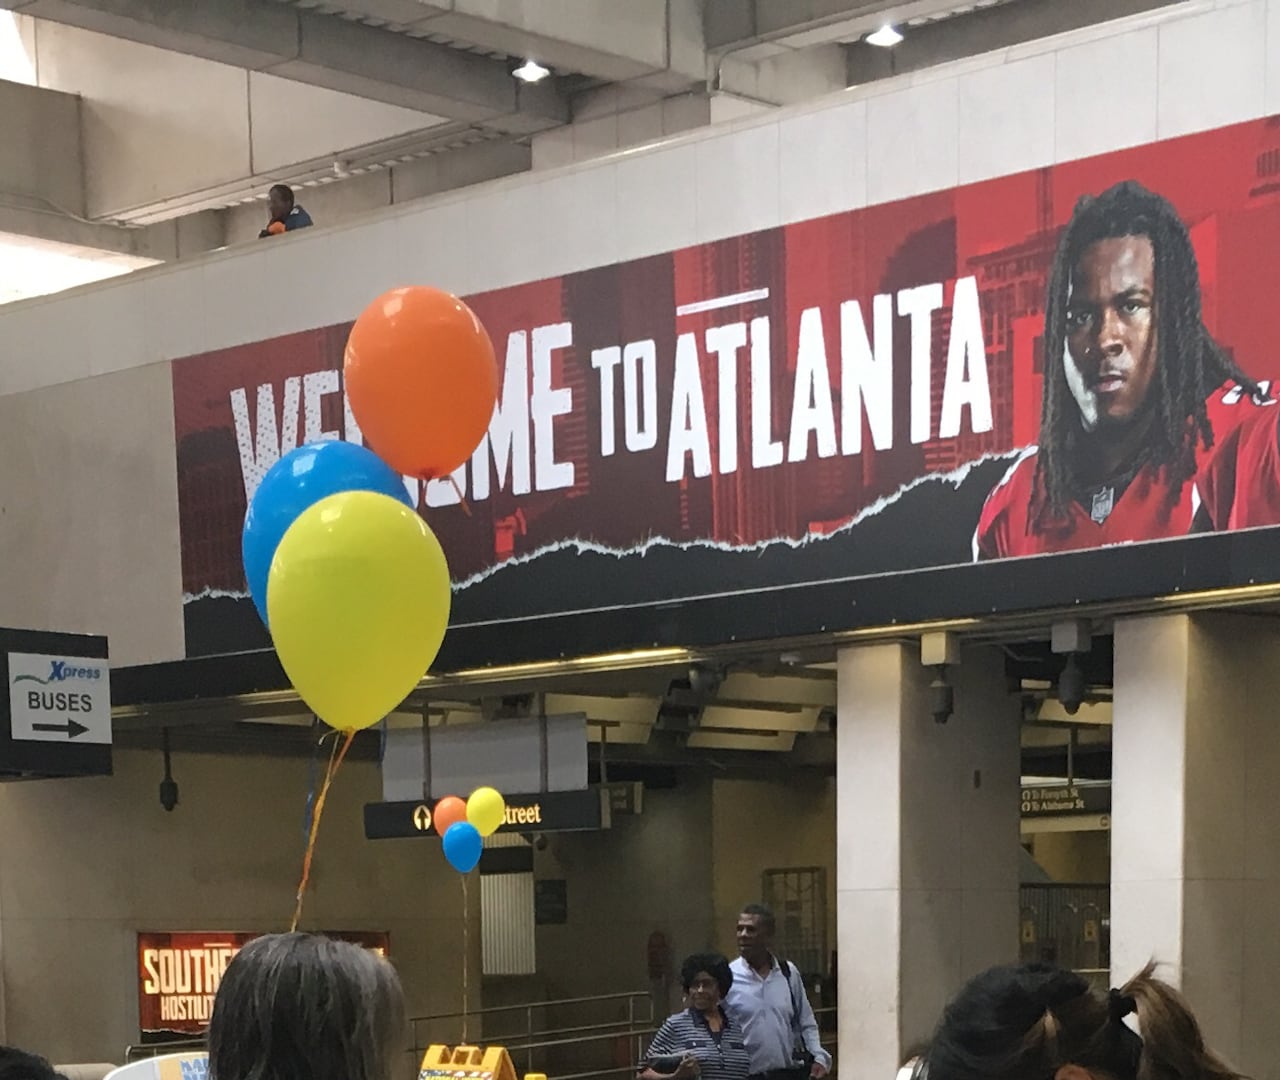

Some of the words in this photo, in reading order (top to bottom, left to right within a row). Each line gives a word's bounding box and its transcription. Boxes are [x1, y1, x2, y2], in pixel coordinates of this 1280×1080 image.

[591, 339, 657, 456] TO
[665, 276, 994, 482] ATLANTA
[48, 660, 100, 681] Xpress
[28, 691, 93, 713] BUSES
[161, 995, 215, 1021] HOSTILIT
